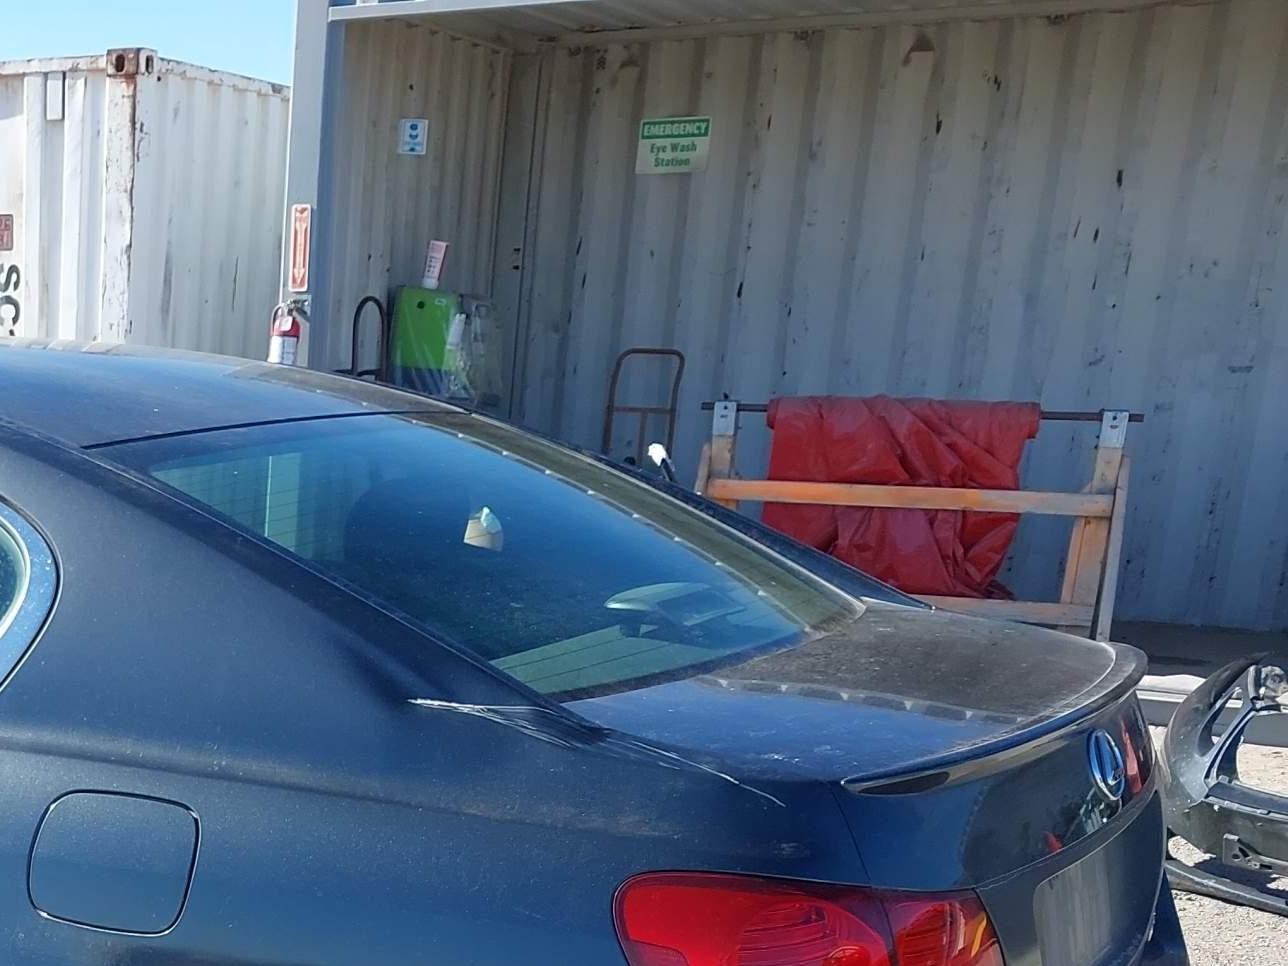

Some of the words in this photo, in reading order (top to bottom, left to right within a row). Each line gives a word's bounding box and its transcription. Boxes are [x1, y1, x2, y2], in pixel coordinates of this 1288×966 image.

[642, 122, 708, 136] EMERGENCY
[650, 143, 668, 157] Eye
[670, 140, 697, 152] Wash
[653, 156, 690, 168] Station
